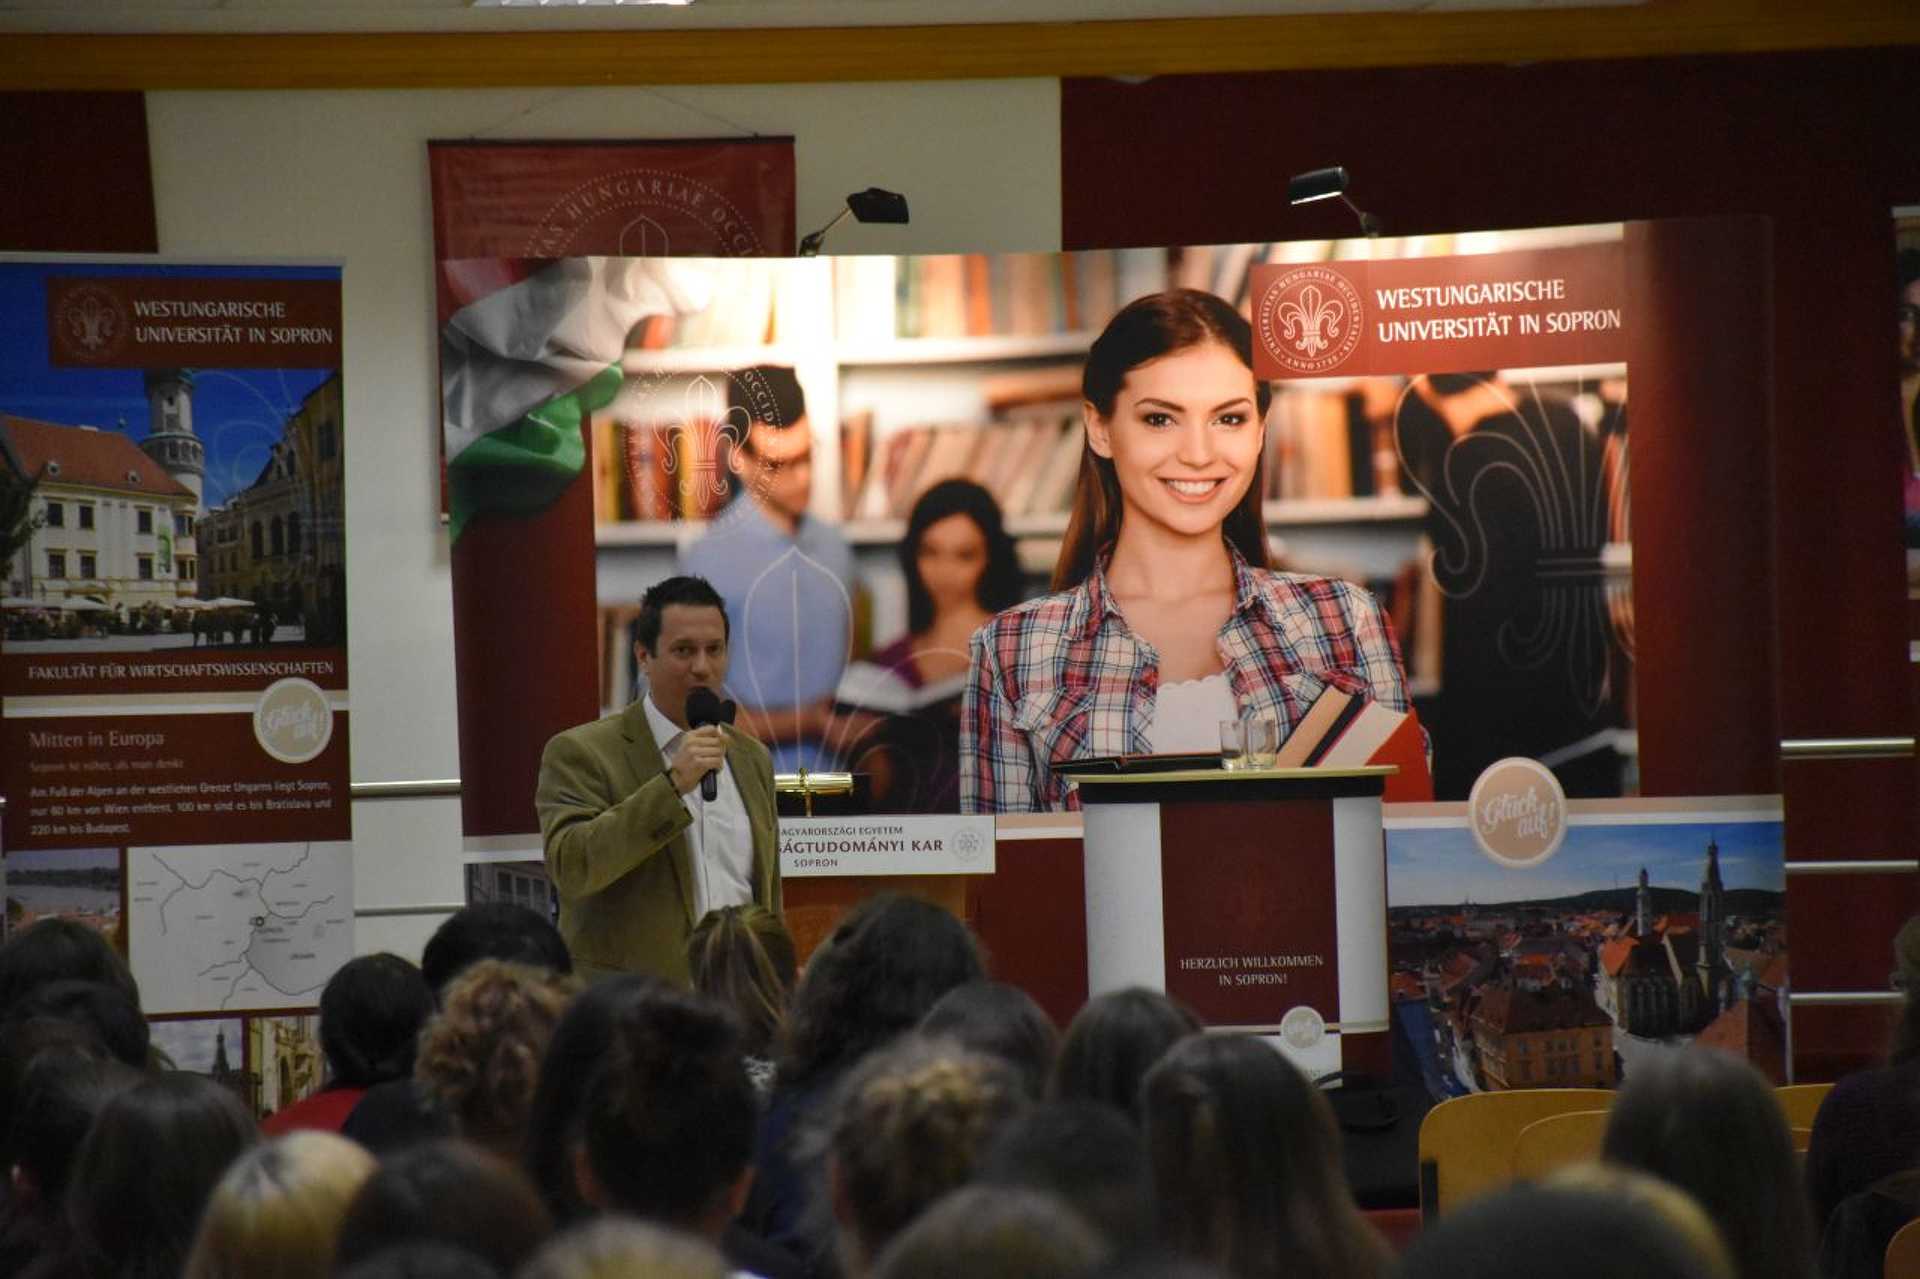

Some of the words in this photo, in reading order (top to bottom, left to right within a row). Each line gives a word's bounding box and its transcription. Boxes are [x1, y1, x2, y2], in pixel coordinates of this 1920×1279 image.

[711, 207, 754, 256] OCCI
[1376, 279, 1565, 310] WESTUNGARISCHE
[133, 300, 287, 318] WESTUNGARISCHE
[135, 324, 243, 343] UNIVERSITÄT
[249, 327, 265, 343] IN
[271, 327, 333, 343] SOPRON
[1377, 312, 1512, 343] UNIVERSITÄT
[1520, 314, 1541, 335] IN
[1546, 309, 1622, 334] SOPRON
[28, 661, 96, 679] FAKULTÄT
[99, 661, 126, 678] FÜR
[128, 661, 335, 677] WIRTSCHAFTSWISSENSCHAFTEN
[30, 731, 83, 748] Mitten
[88, 731, 103, 746] in
[109, 730, 164, 748] Europa
[780, 825, 856, 836] AGYARORSZÁGI
[858, 826, 903, 835] EGYETEM
[911, 839, 943, 852] KAR
[793, 859, 838, 868] SOPRON
[1180, 957, 1238, 970] HERZLICH
[1241, 954, 1324, 969] WILLKOMMEN
[1218, 974, 1232, 986] IN
[1235, 973, 1288, 986] SOPRON!
